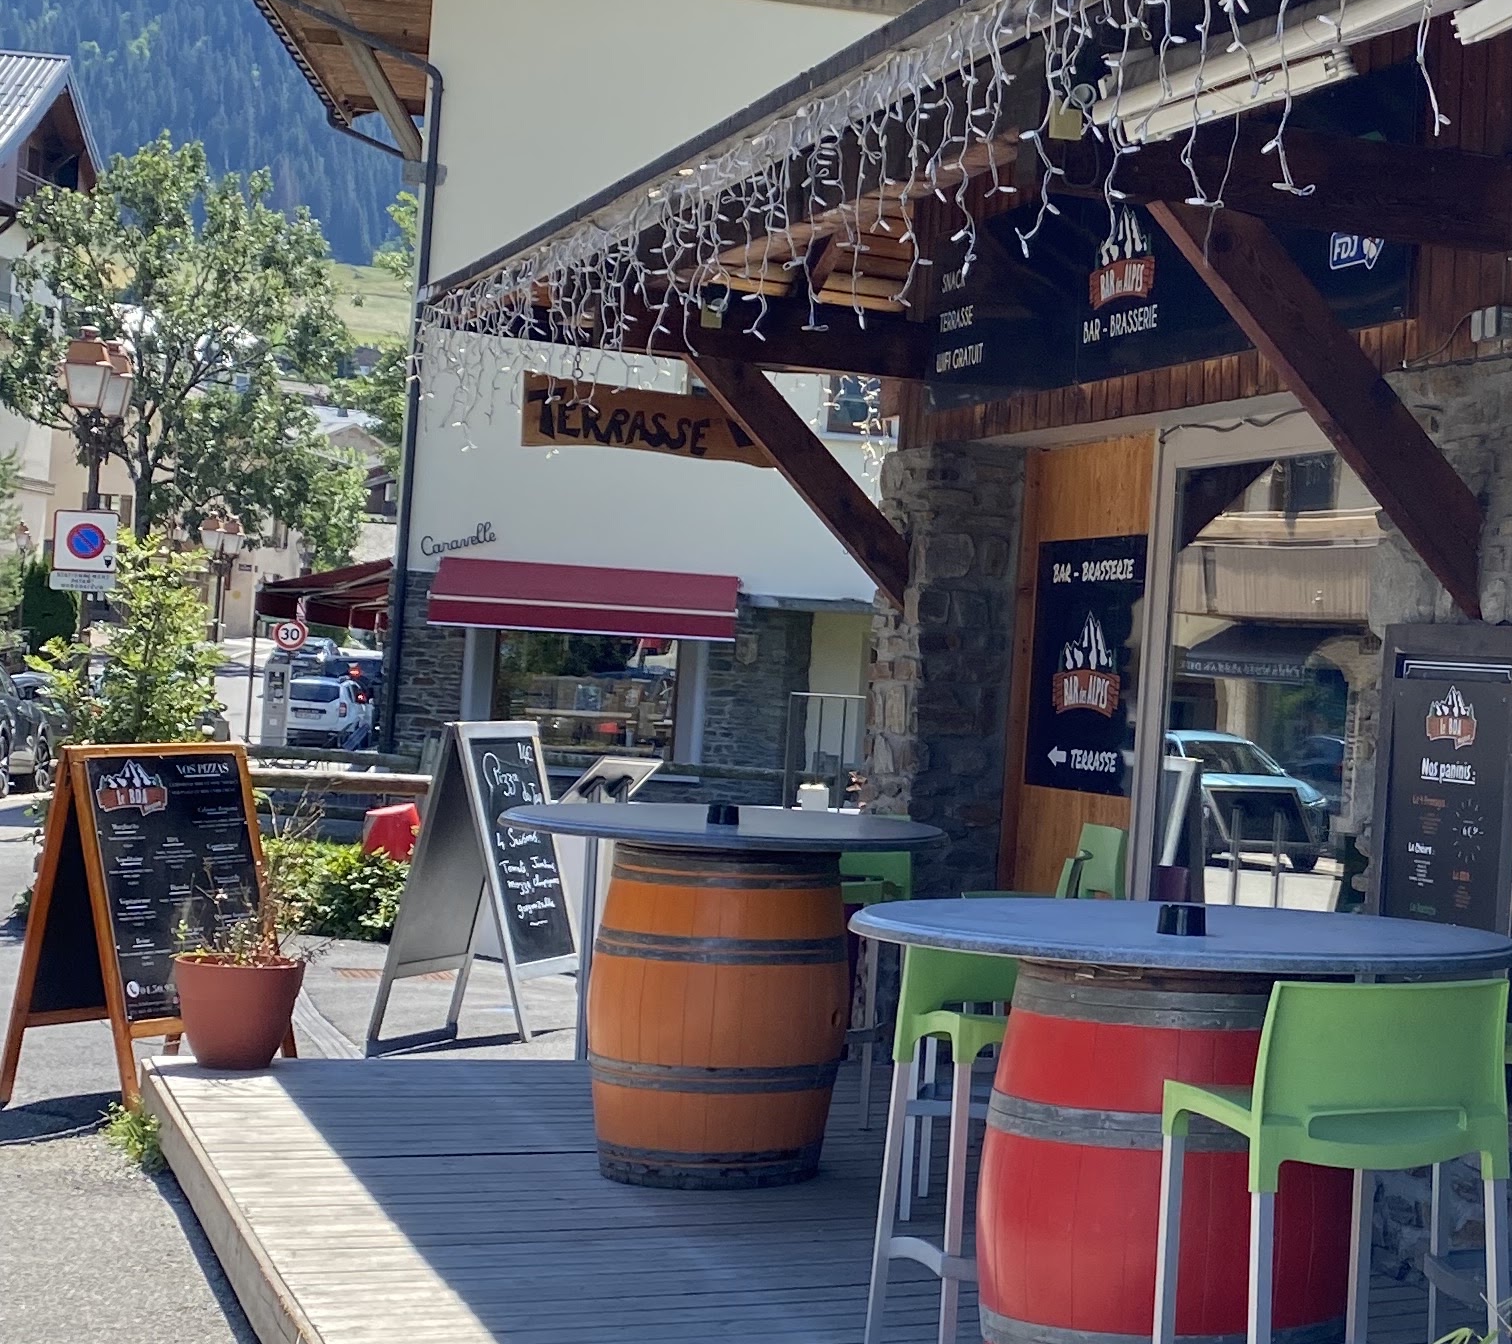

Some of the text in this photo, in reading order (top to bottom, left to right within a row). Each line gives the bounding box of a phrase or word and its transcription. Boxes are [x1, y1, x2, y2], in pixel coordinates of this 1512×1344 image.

[1333, 235, 1359, 261] FDJ
[941, 269, 966, 293] SNACK
[1100, 269, 1115, 301] BAR
[1123, 263, 1145, 292] ALPES
[940, 305, 974, 333] TERRASSE
[1083, 318, 1101, 344] BAR
[1109, 304, 1158, 337] BRASSERIE
[936, 343, 983, 373] WIFI GRATUIT
[528, 387, 711, 456] TERRASSE
[420, 521, 497, 556] Caravelle
[1053, 562, 1071, 583] BAR
[1082, 558, 1135, 582] BRASSERIE
[281, 627, 299, 641] 30
[1064, 675, 1079, 706] BAR
[1087, 675, 1110, 709] ALPES
[197, 762, 230, 774] PIZZAS
[1070, 749, 1118, 773] TERRASSE
[1421, 757, 1439, 777] Nos
[1439, 760, 1472, 784] paninis
